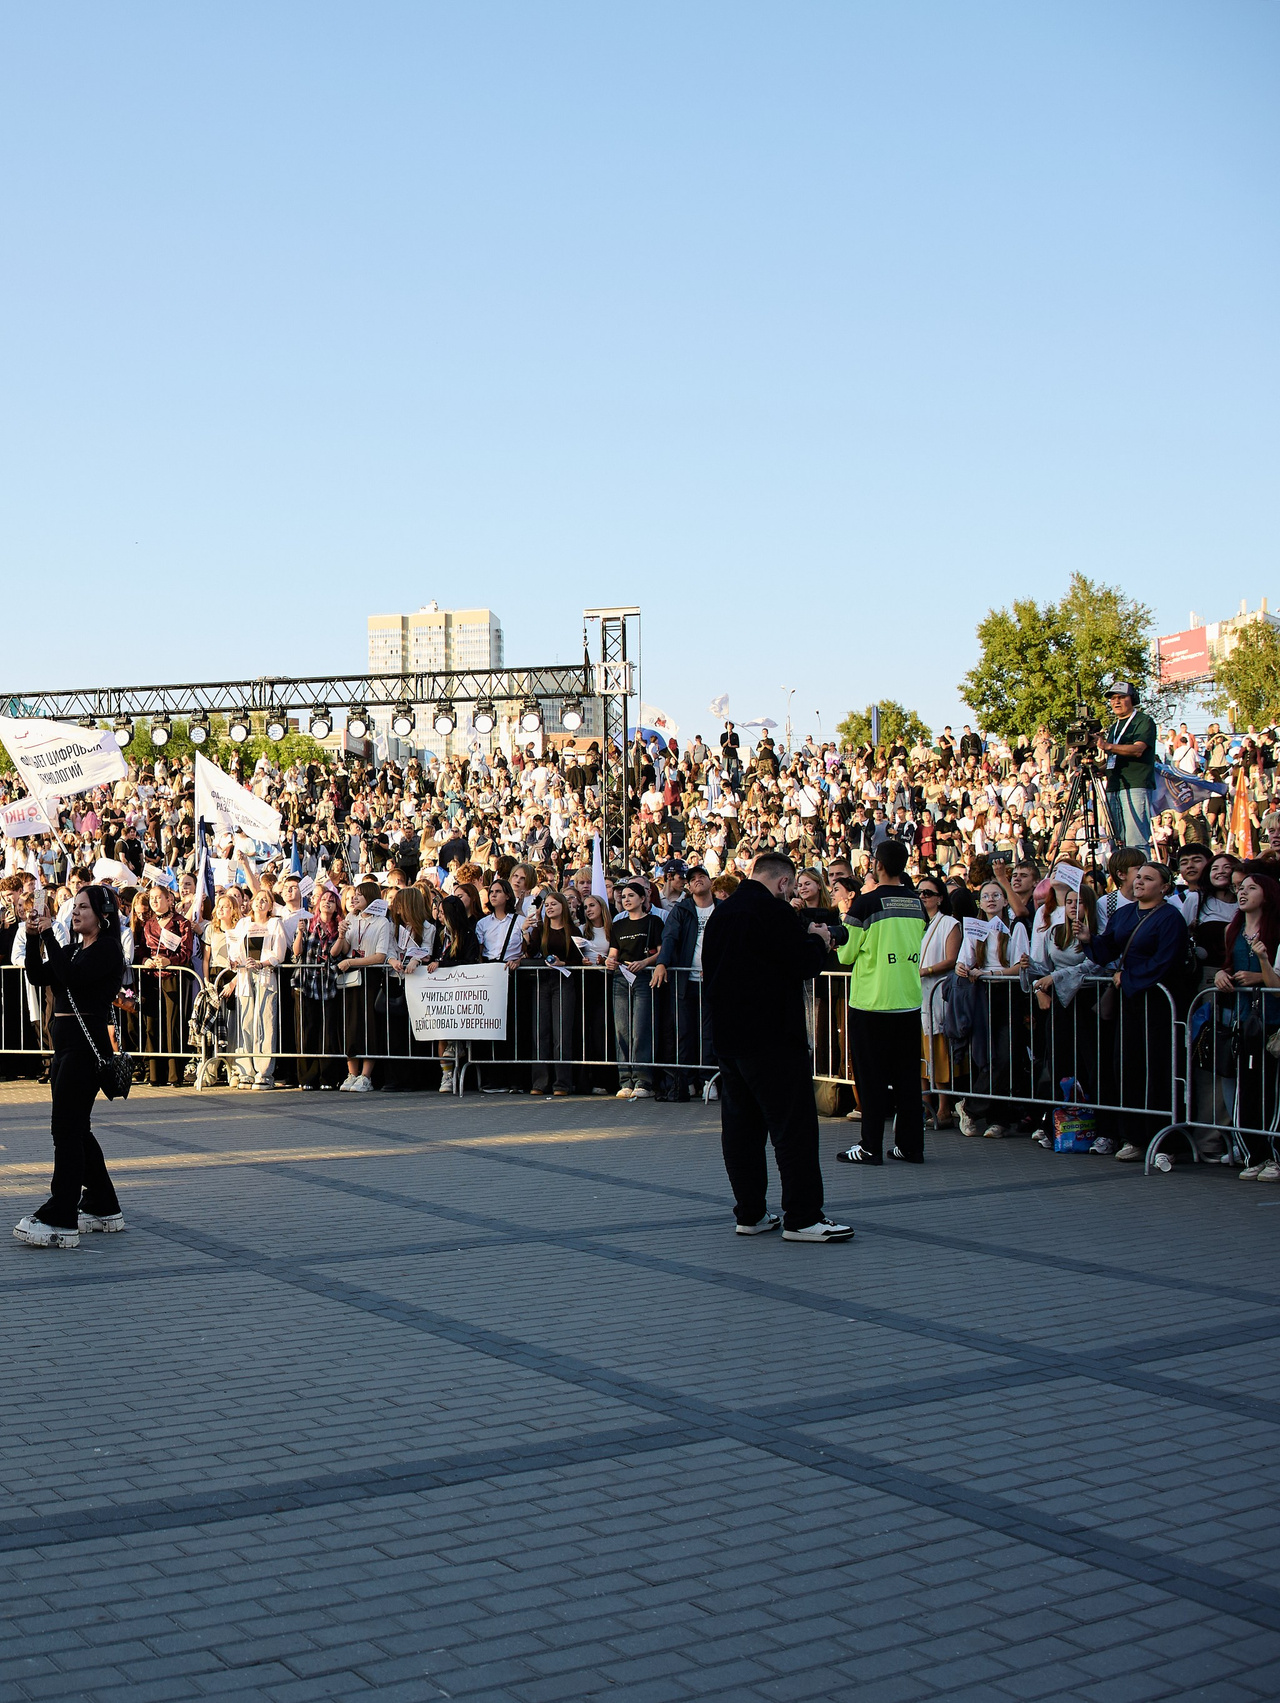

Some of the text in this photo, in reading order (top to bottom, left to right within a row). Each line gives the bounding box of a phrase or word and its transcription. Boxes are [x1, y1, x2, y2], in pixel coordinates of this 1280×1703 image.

[421, 990, 490, 1002] УЧИТЬСЯ ОТКРЫТО,
[425, 1004, 485, 1017] ДУМАТЬ СМЕЛО,
[415, 1017, 502, 1032] ДЕЙСТВОВАТЬ УВЕРЕННО!
